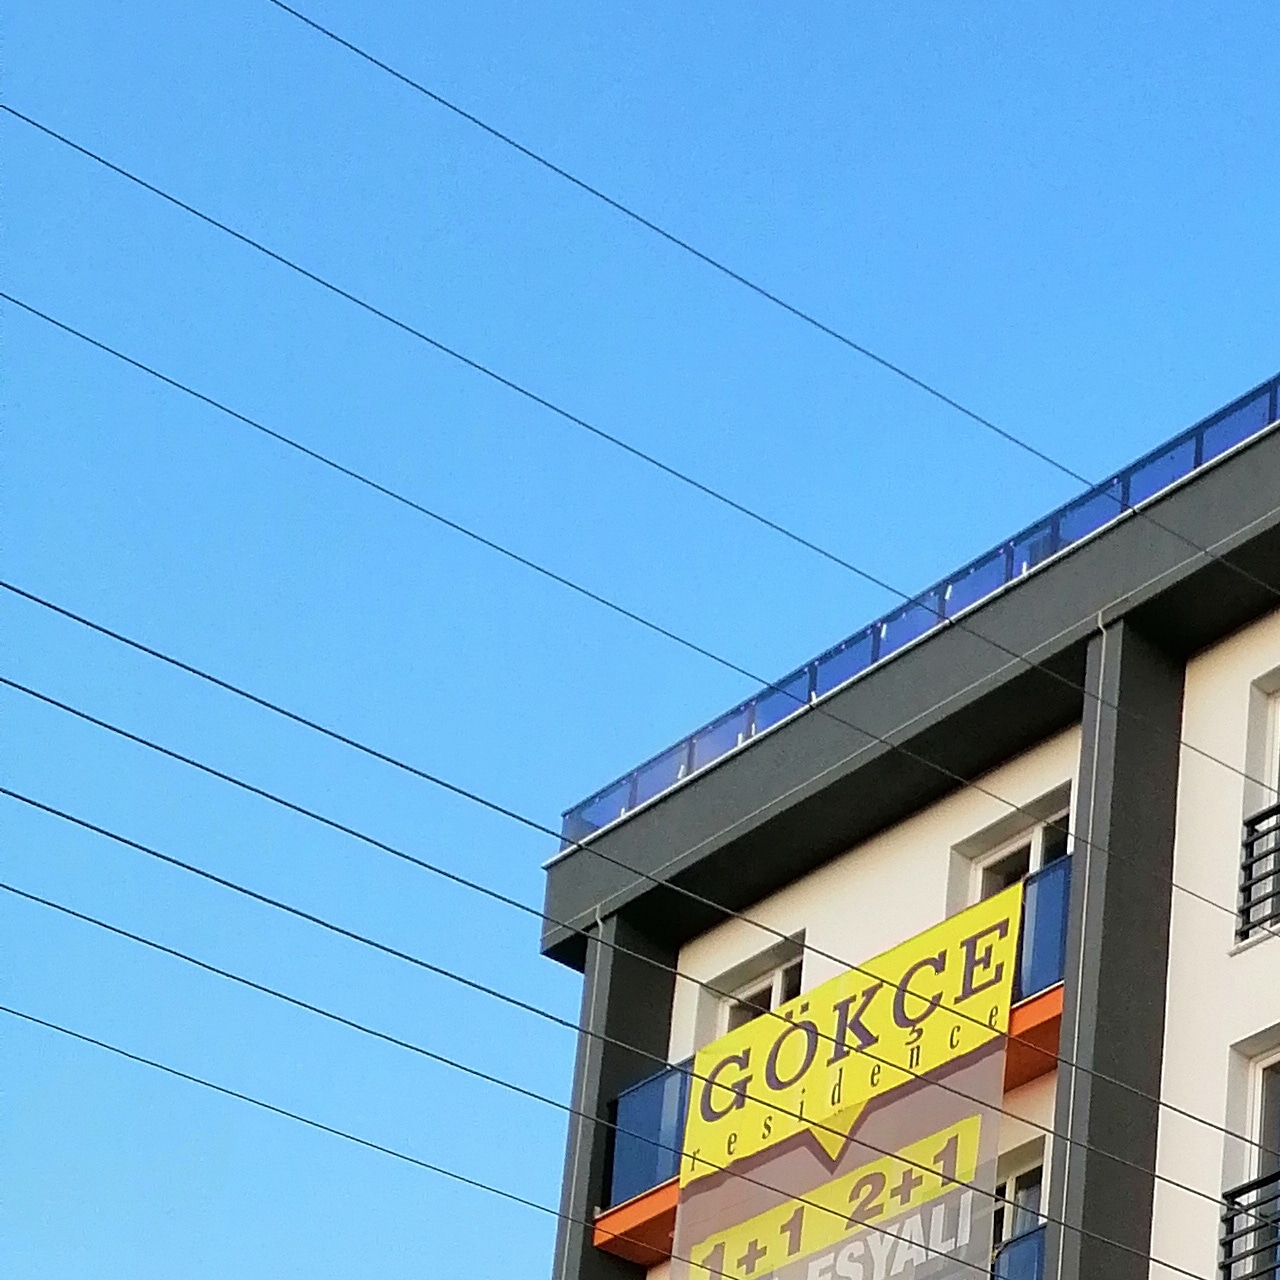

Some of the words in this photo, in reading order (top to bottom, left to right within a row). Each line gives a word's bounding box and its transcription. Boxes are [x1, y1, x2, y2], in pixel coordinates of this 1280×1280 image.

[690, 1004, 999, 1172] residence
[699, 917, 1010, 1122] GÖKÇE
[844, 1133, 959, 1231] 2+1
